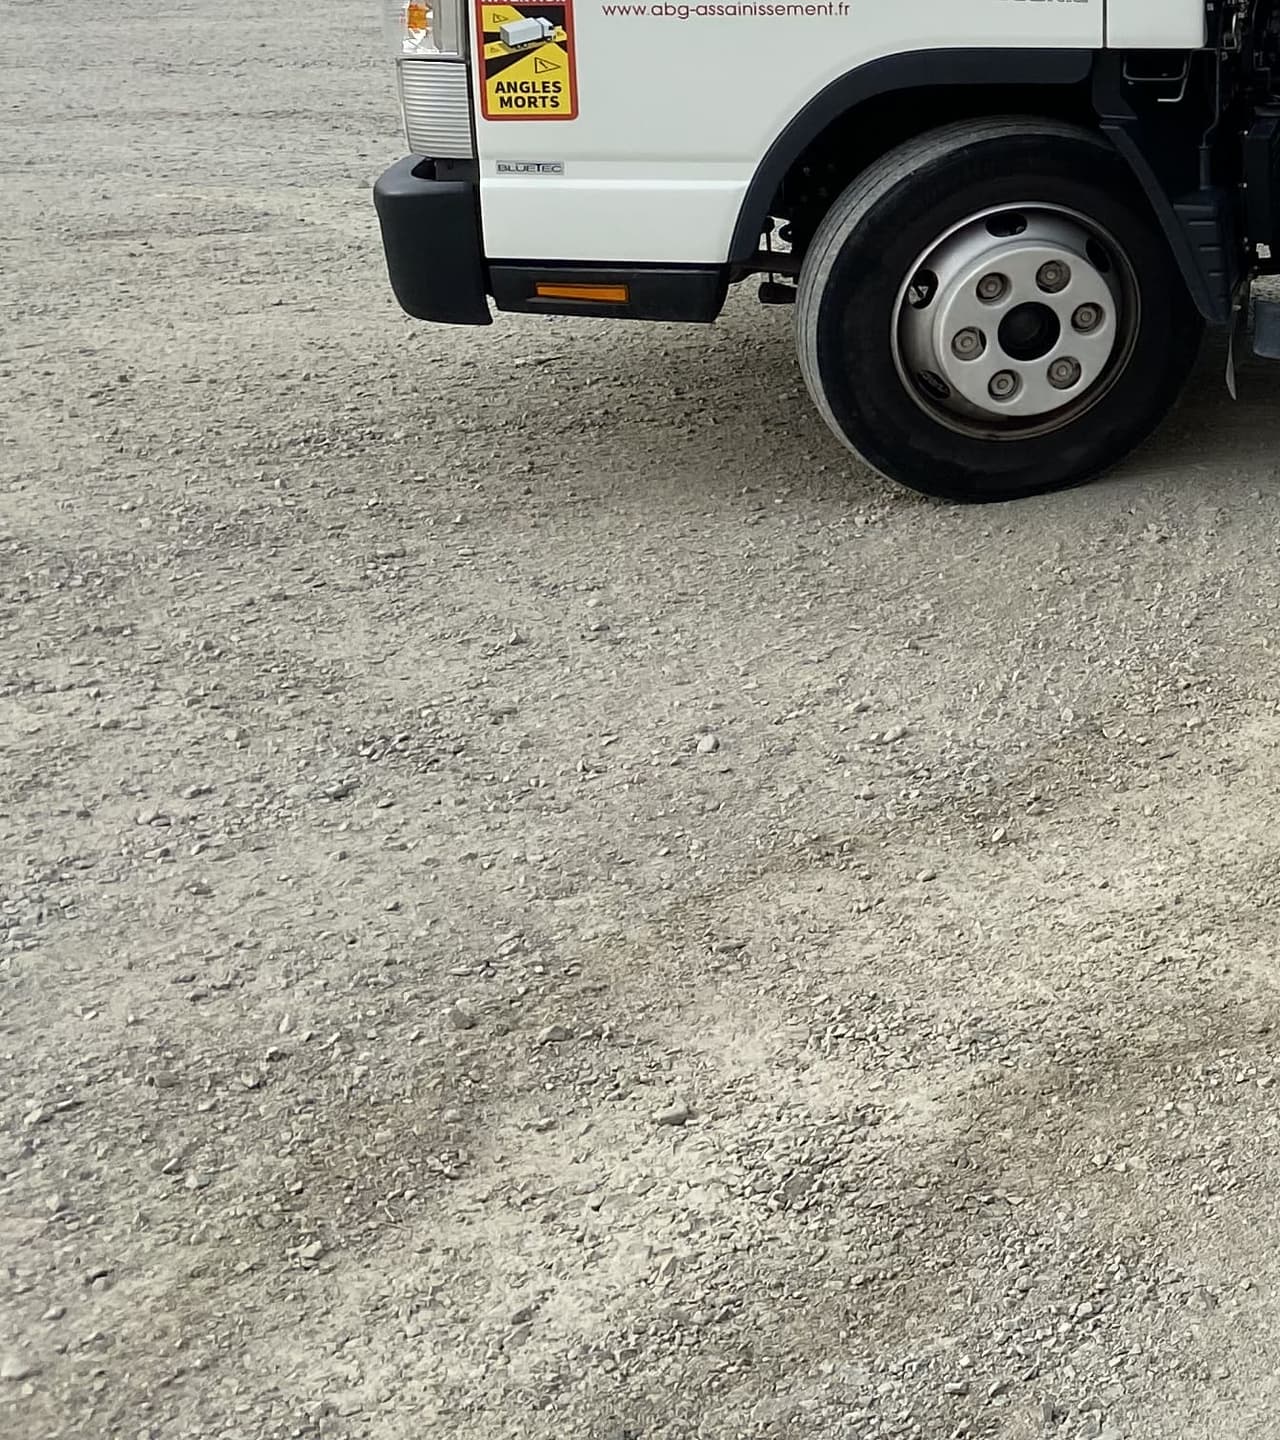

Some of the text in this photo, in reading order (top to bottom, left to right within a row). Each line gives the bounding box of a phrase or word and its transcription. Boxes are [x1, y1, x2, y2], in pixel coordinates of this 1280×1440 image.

[602, 1, 850, 20] www.abg-assainissement.fr
[495, 81, 562, 94] ANGLES
[500, 95, 560, 108] MORTS
[498, 163, 562, 173] BLUETEC
